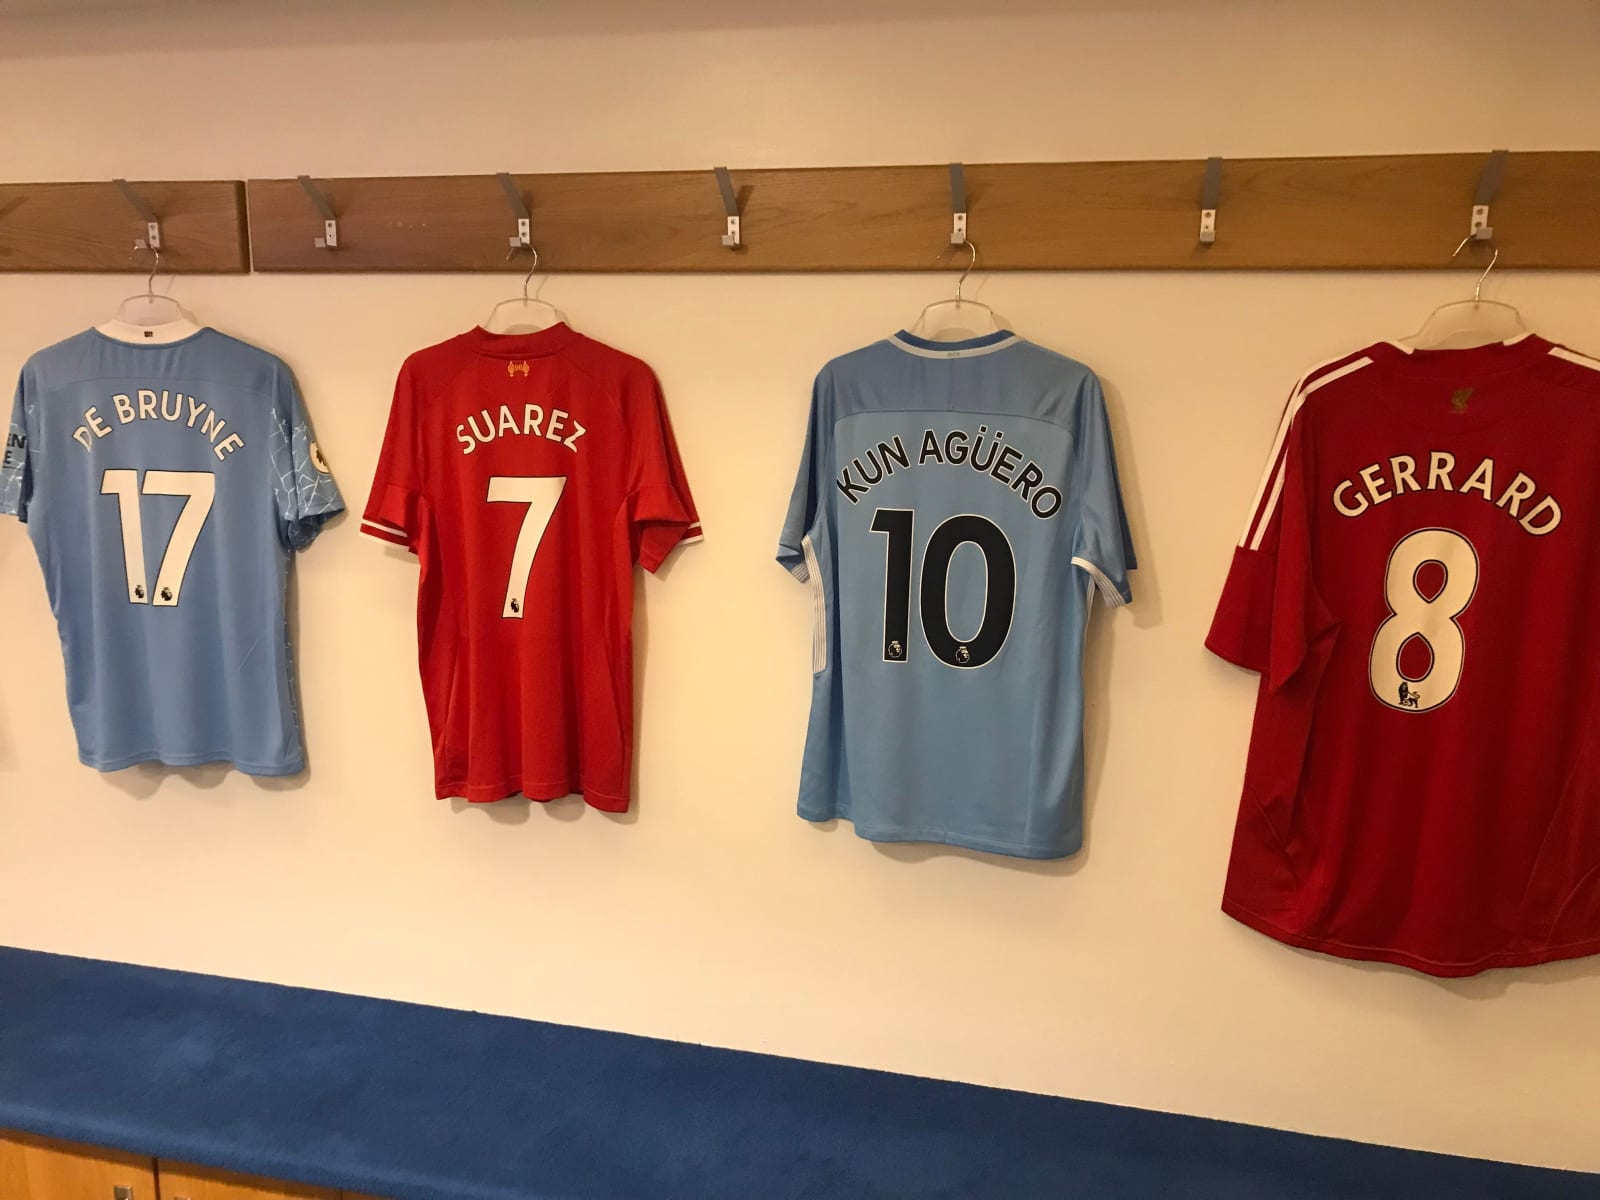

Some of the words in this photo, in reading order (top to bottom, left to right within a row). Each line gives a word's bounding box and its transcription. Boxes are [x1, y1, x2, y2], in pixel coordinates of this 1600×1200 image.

[72, 406, 113, 452] DE
[112, 389, 246, 461] BRUYNE
[456, 403, 587, 454] SUAREZ
[836, 435, 911, 505] KUN
[918, 424, 1063, 520] AGÜERO
[100, 469, 216, 607] 17
[486, 475, 568, 619] 7
[1332, 450, 1563, 536] GERRARD
[869, 508, 1017, 669] 10
[1368, 526, 1480, 713] 8
